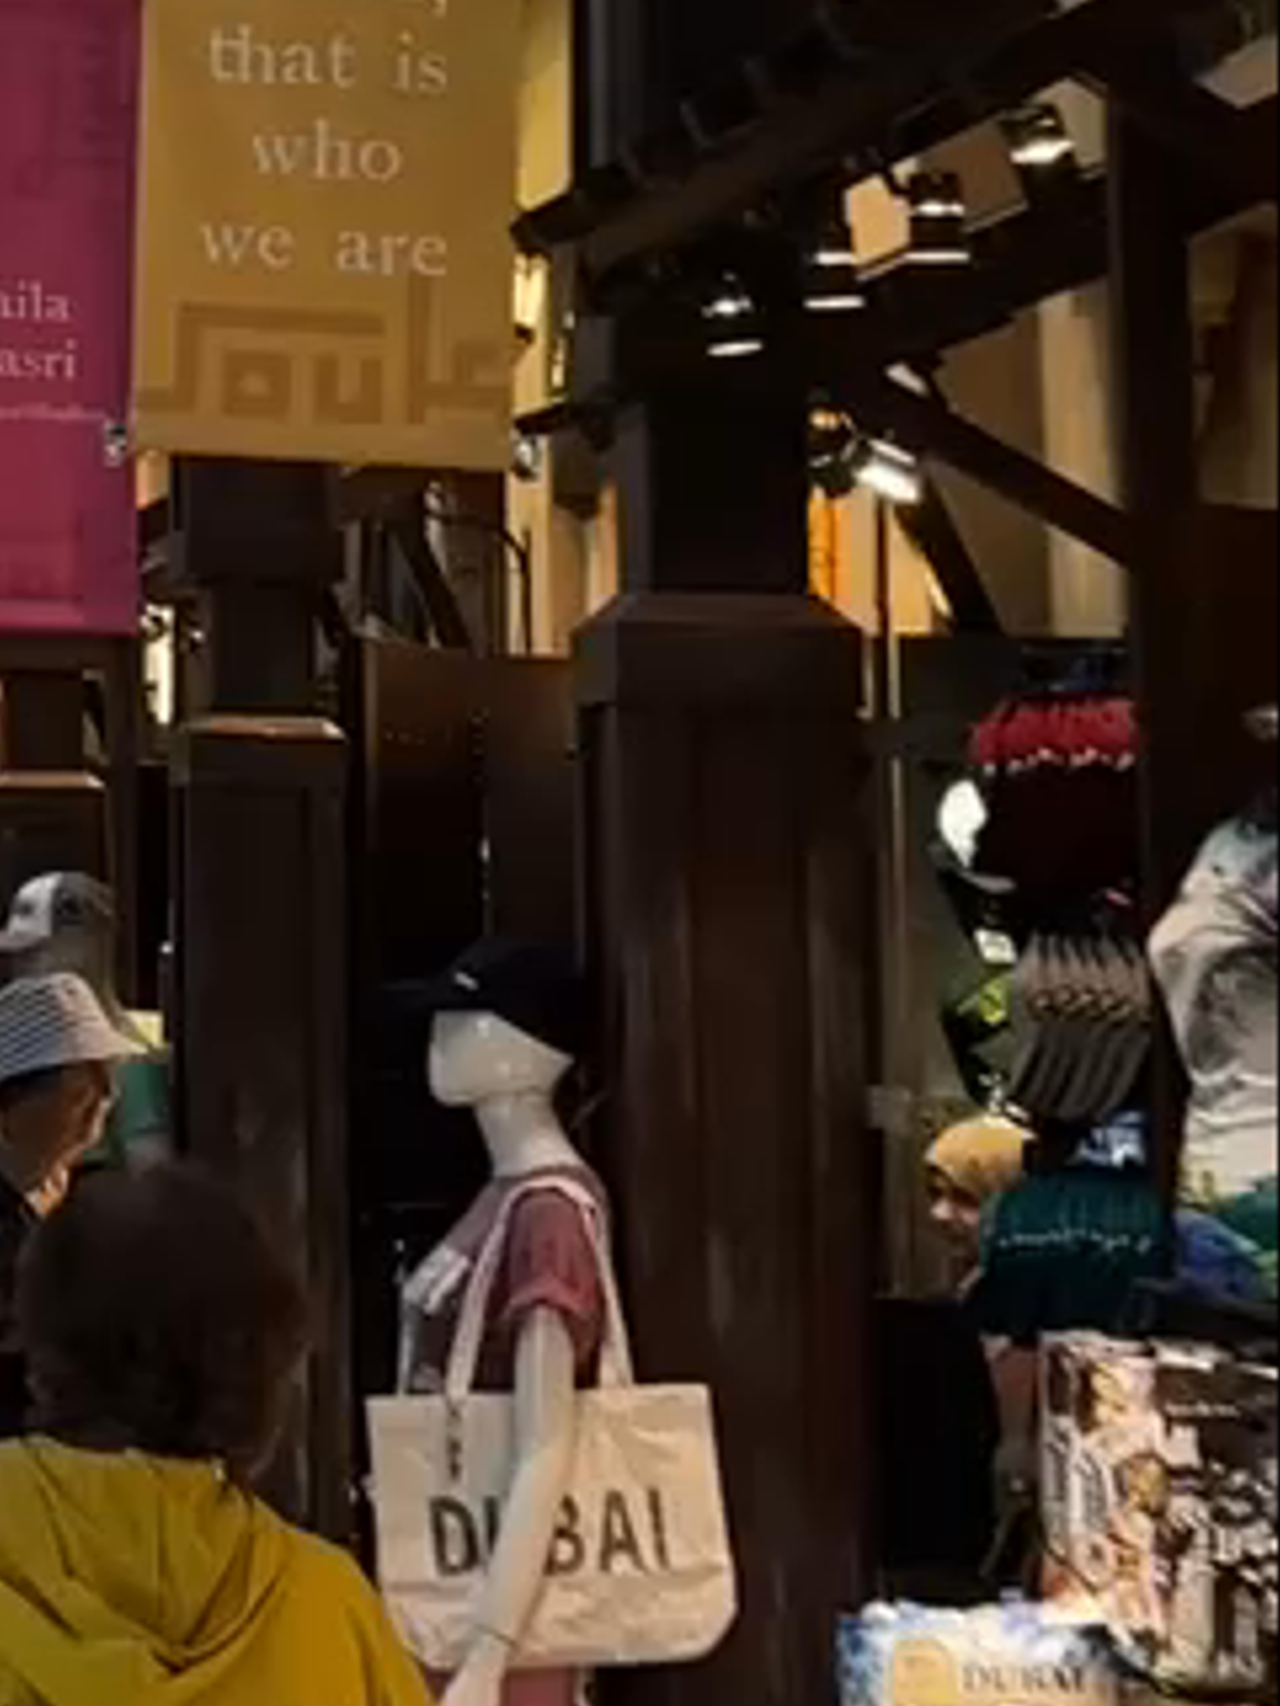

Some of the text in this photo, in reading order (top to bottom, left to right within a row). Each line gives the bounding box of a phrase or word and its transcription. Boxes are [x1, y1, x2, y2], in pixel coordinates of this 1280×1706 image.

[209, 24, 448, 92] that is
[251, 118, 403, 183] who
[201, 220, 448, 277] we are
